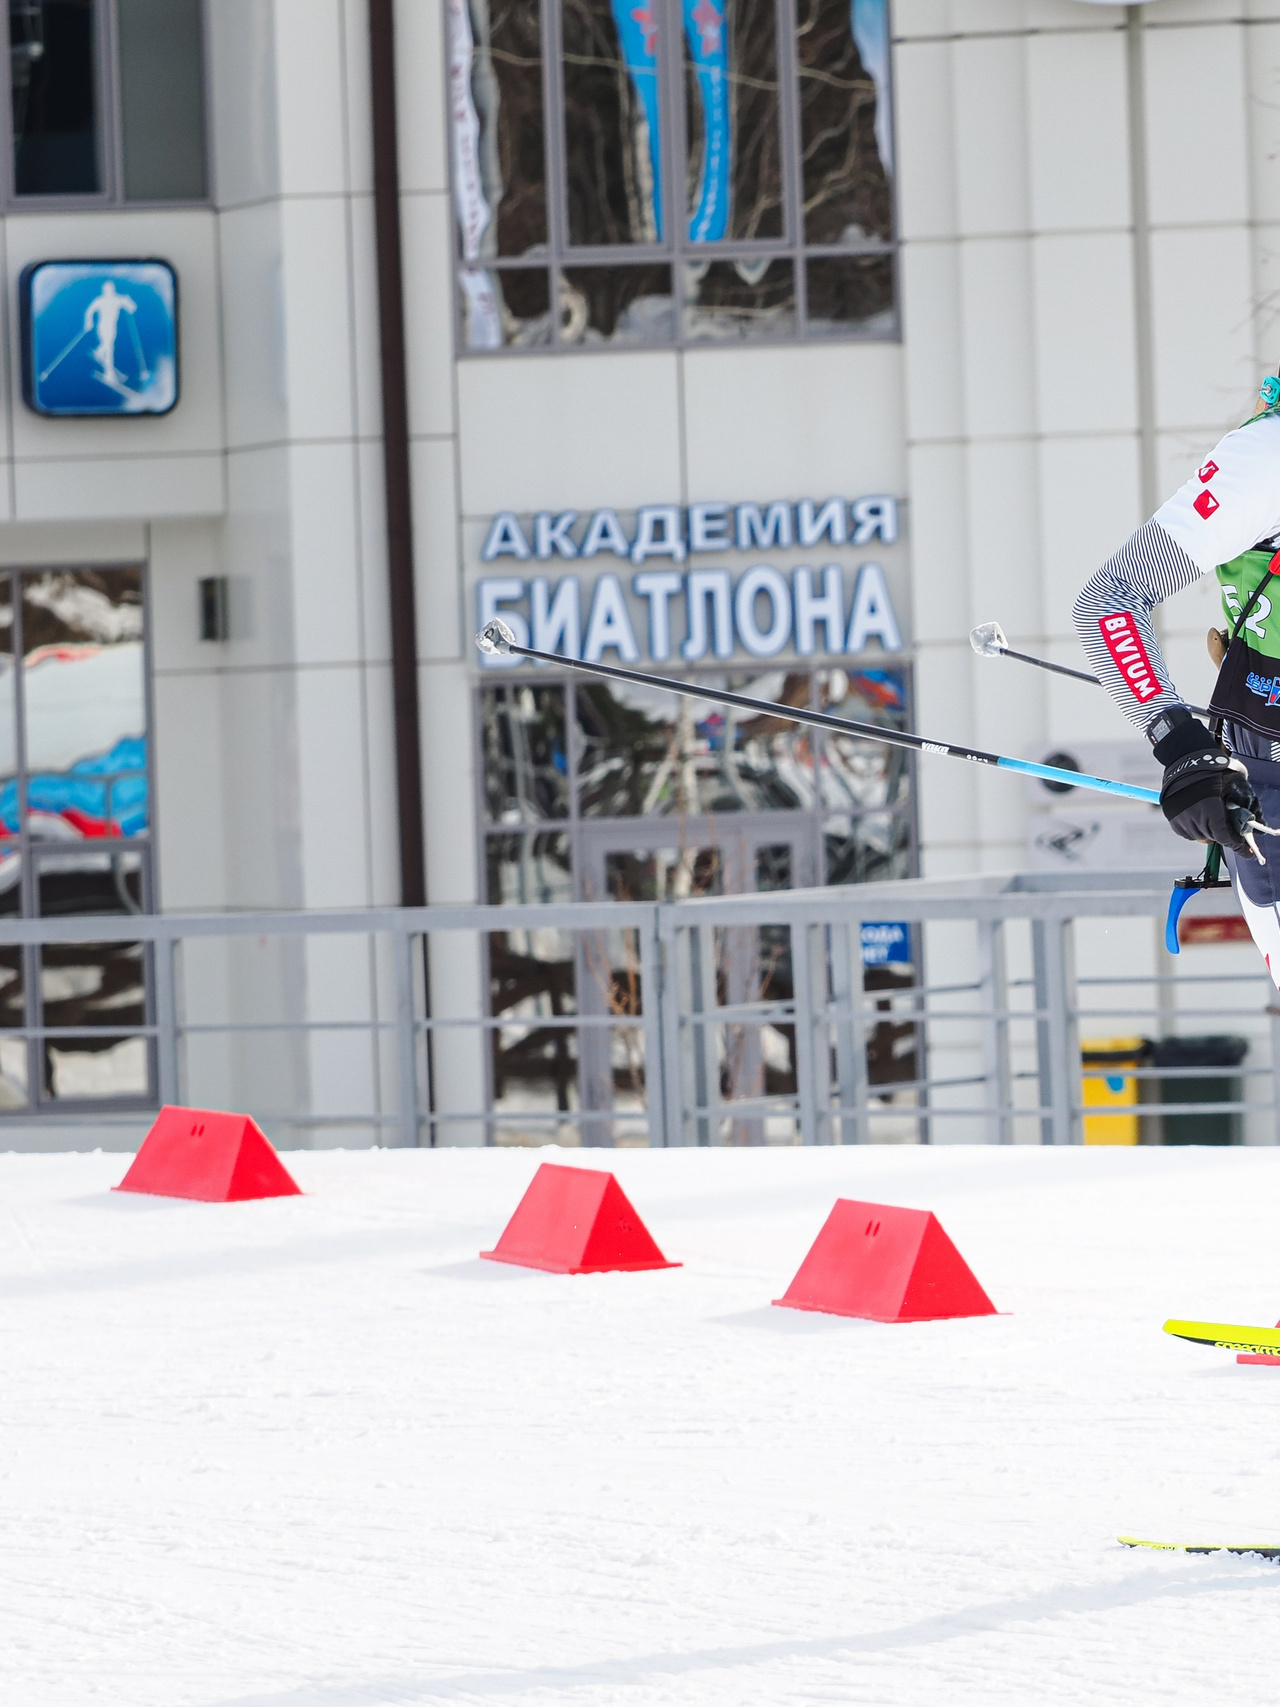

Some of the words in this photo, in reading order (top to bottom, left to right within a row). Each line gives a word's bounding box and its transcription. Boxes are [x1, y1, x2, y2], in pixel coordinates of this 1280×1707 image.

[483, 495, 899, 563] АКАДЕМИЯ
[476, 562, 902, 669] БИАТЛОНА
[1105, 616, 1156, 699] BIVIUM
